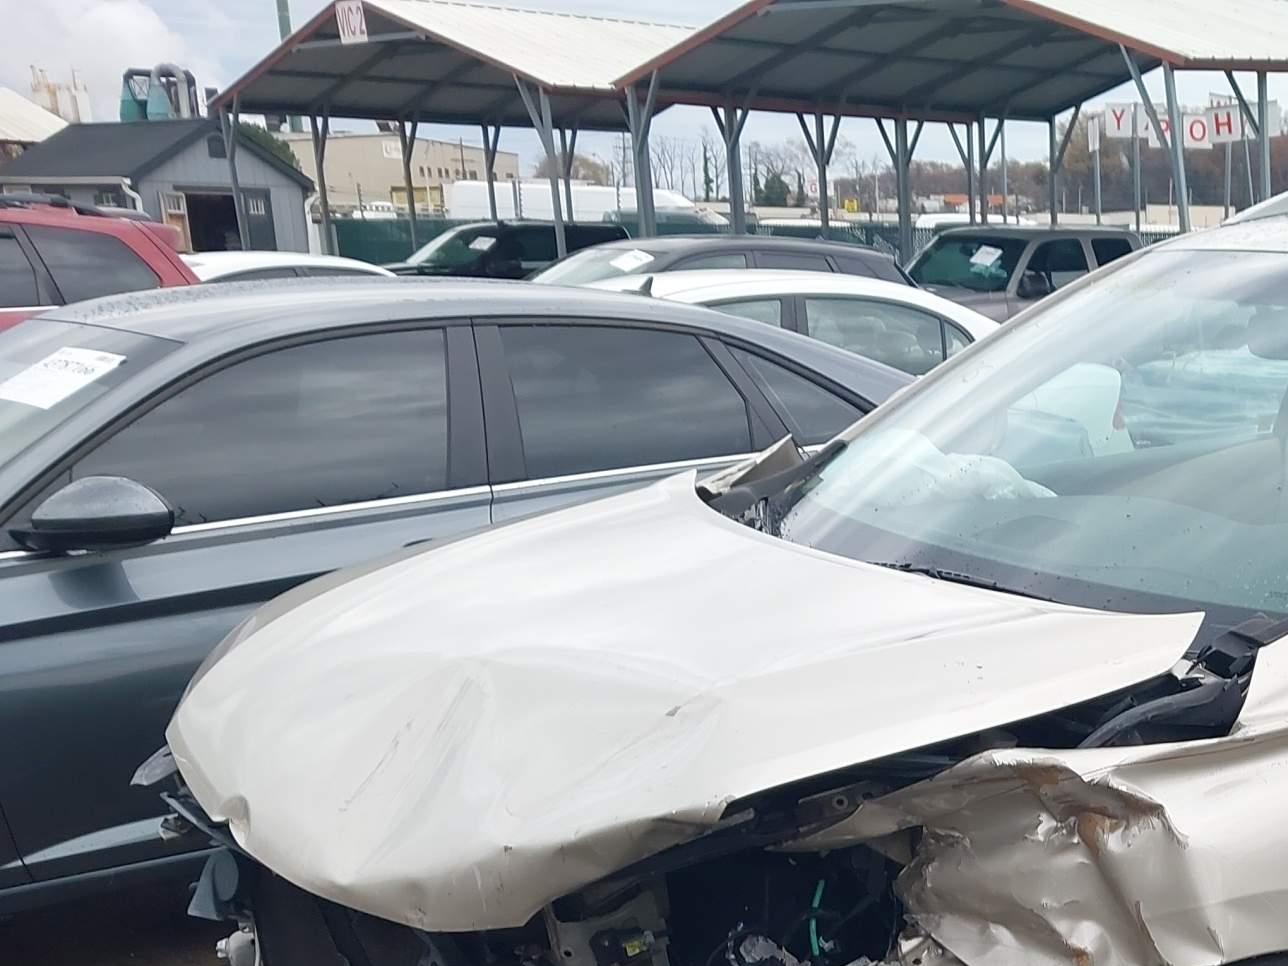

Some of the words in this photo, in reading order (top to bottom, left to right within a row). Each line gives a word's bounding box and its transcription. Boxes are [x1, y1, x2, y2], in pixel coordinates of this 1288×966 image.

[356, 6, 366, 36] 2
[1112, 109, 1125, 130] Y
[1189, 119, 1206, 141] O
[1214, 111, 1232, 136] H
